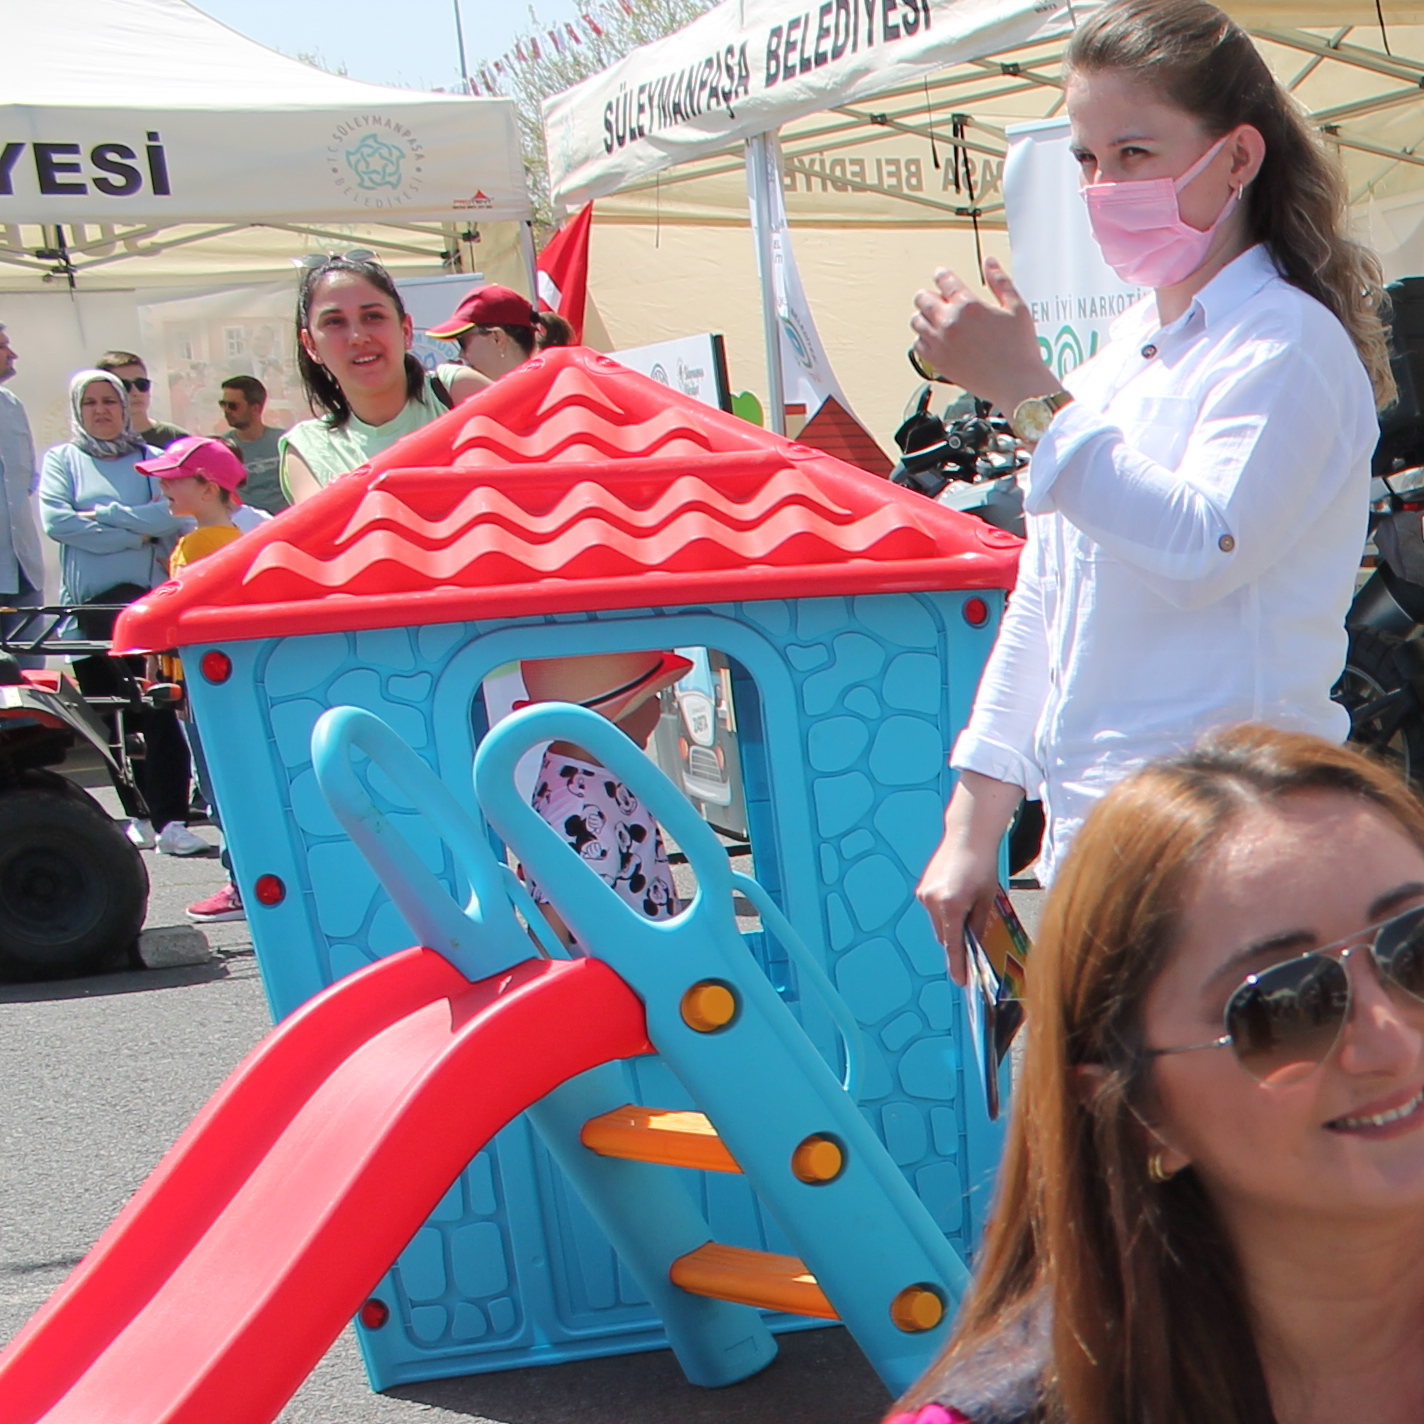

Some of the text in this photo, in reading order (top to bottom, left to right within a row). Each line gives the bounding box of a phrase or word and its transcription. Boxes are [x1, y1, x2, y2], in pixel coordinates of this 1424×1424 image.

[603, 40, 750, 154] SÜLEYMANPAŞA
[1031, 301, 1051, 323] EN
[1055, 294, 1074, 322] İYİ
